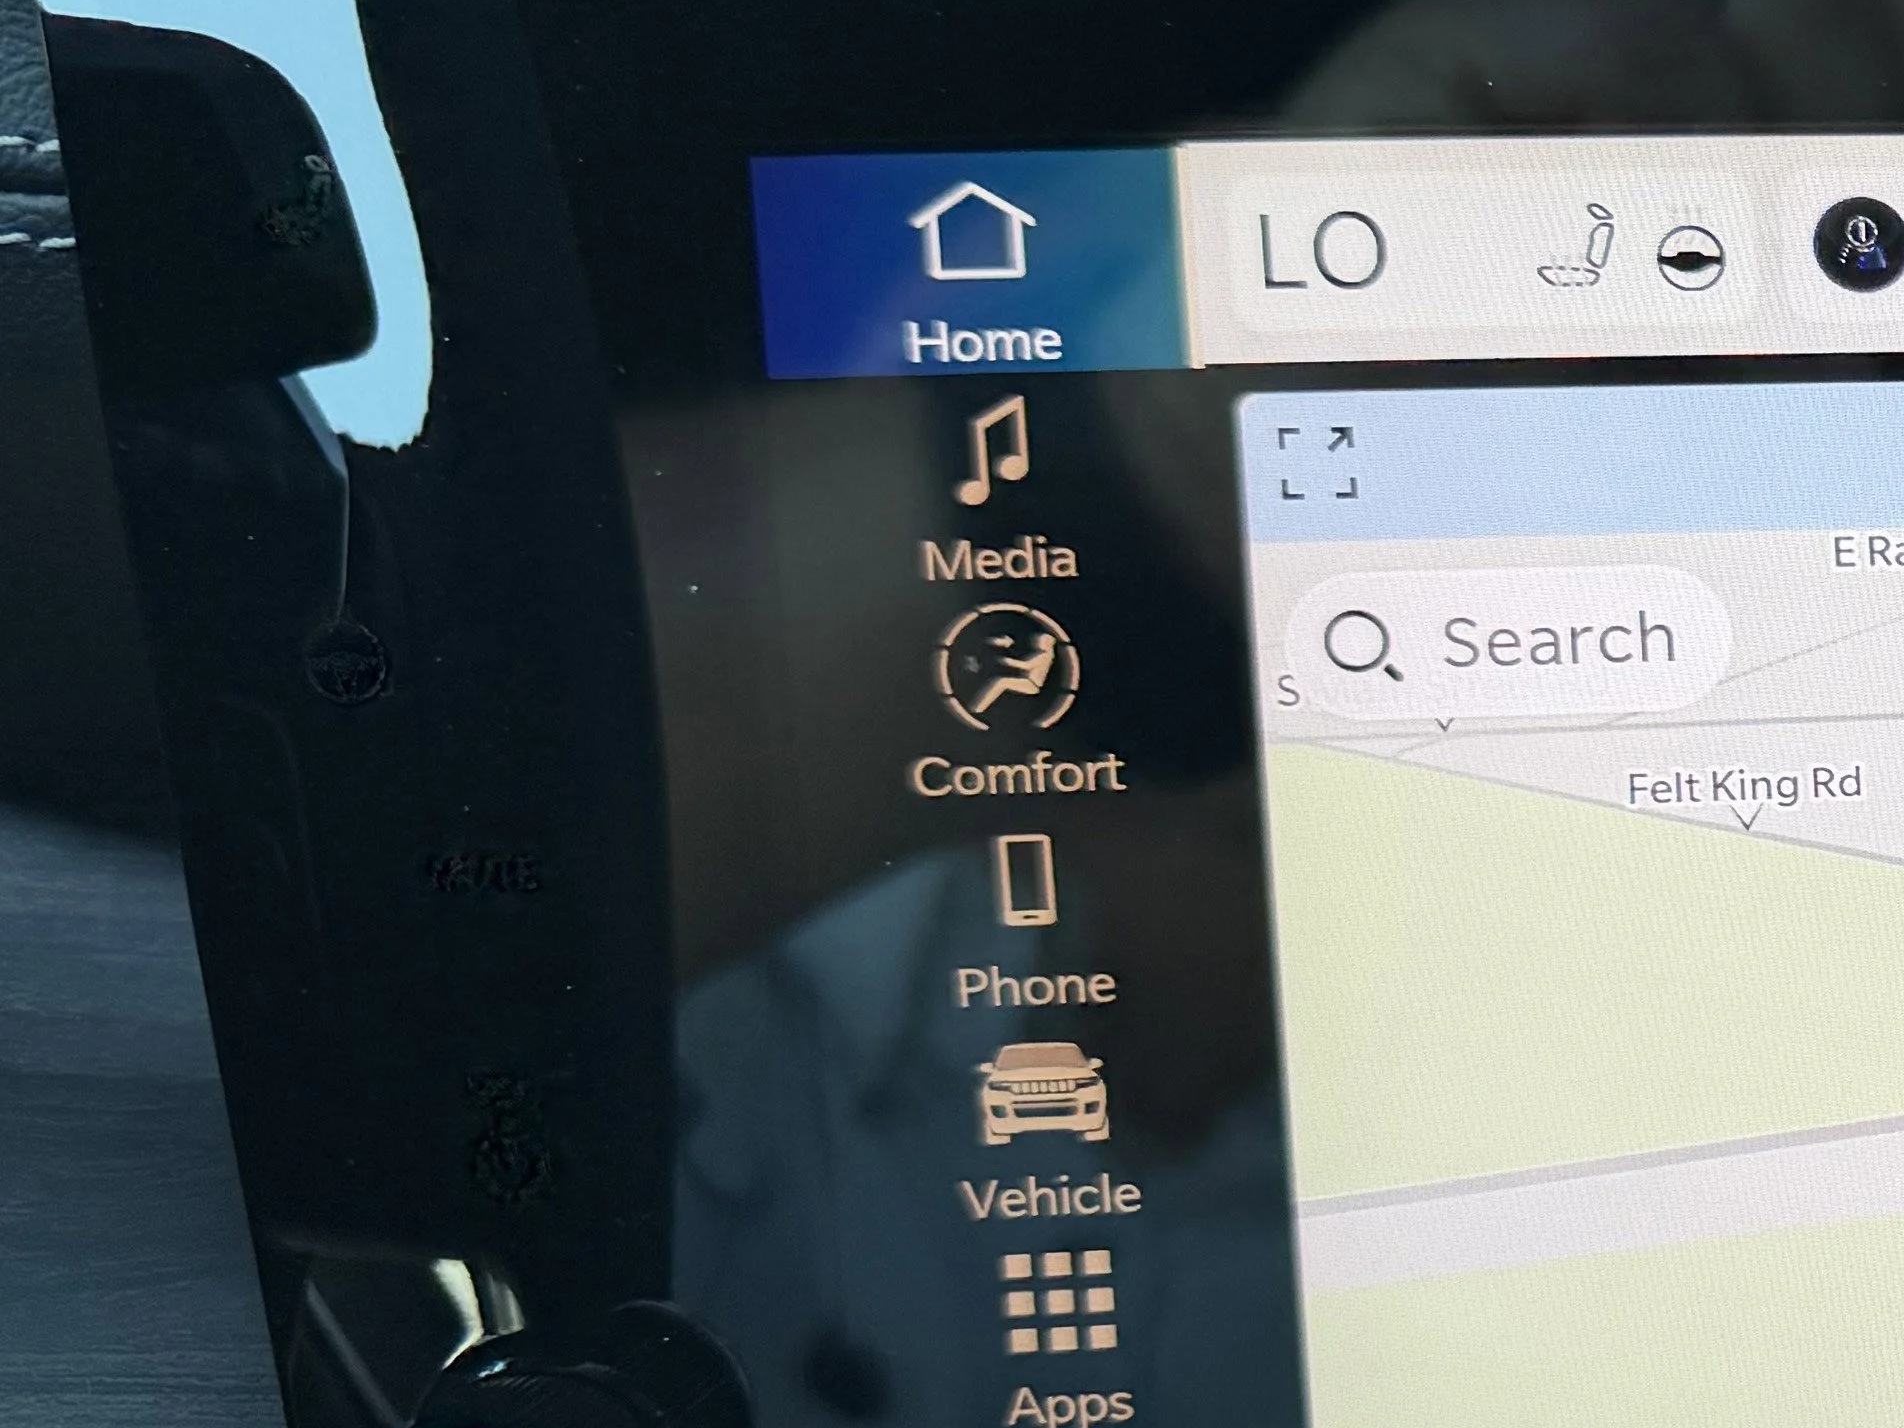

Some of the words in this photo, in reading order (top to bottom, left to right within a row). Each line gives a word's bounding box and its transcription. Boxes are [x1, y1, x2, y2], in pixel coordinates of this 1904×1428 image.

[1259, 209, 1388, 291] LO
[903, 320, 1064, 364] Home
[920, 536, 1080, 582] Media
[1834, 537, 1857, 568] E
[1442, 609, 1677, 669] Search
[911, 749, 1128, 797] Comfort
[1628, 771, 1702, 804] Felt
[1711, 768, 1801, 810] King
[1813, 766, 1863, 799] Rd
[955, 964, 1118, 1009] Phone
[959, 1172, 1143, 1221] Vehicle
